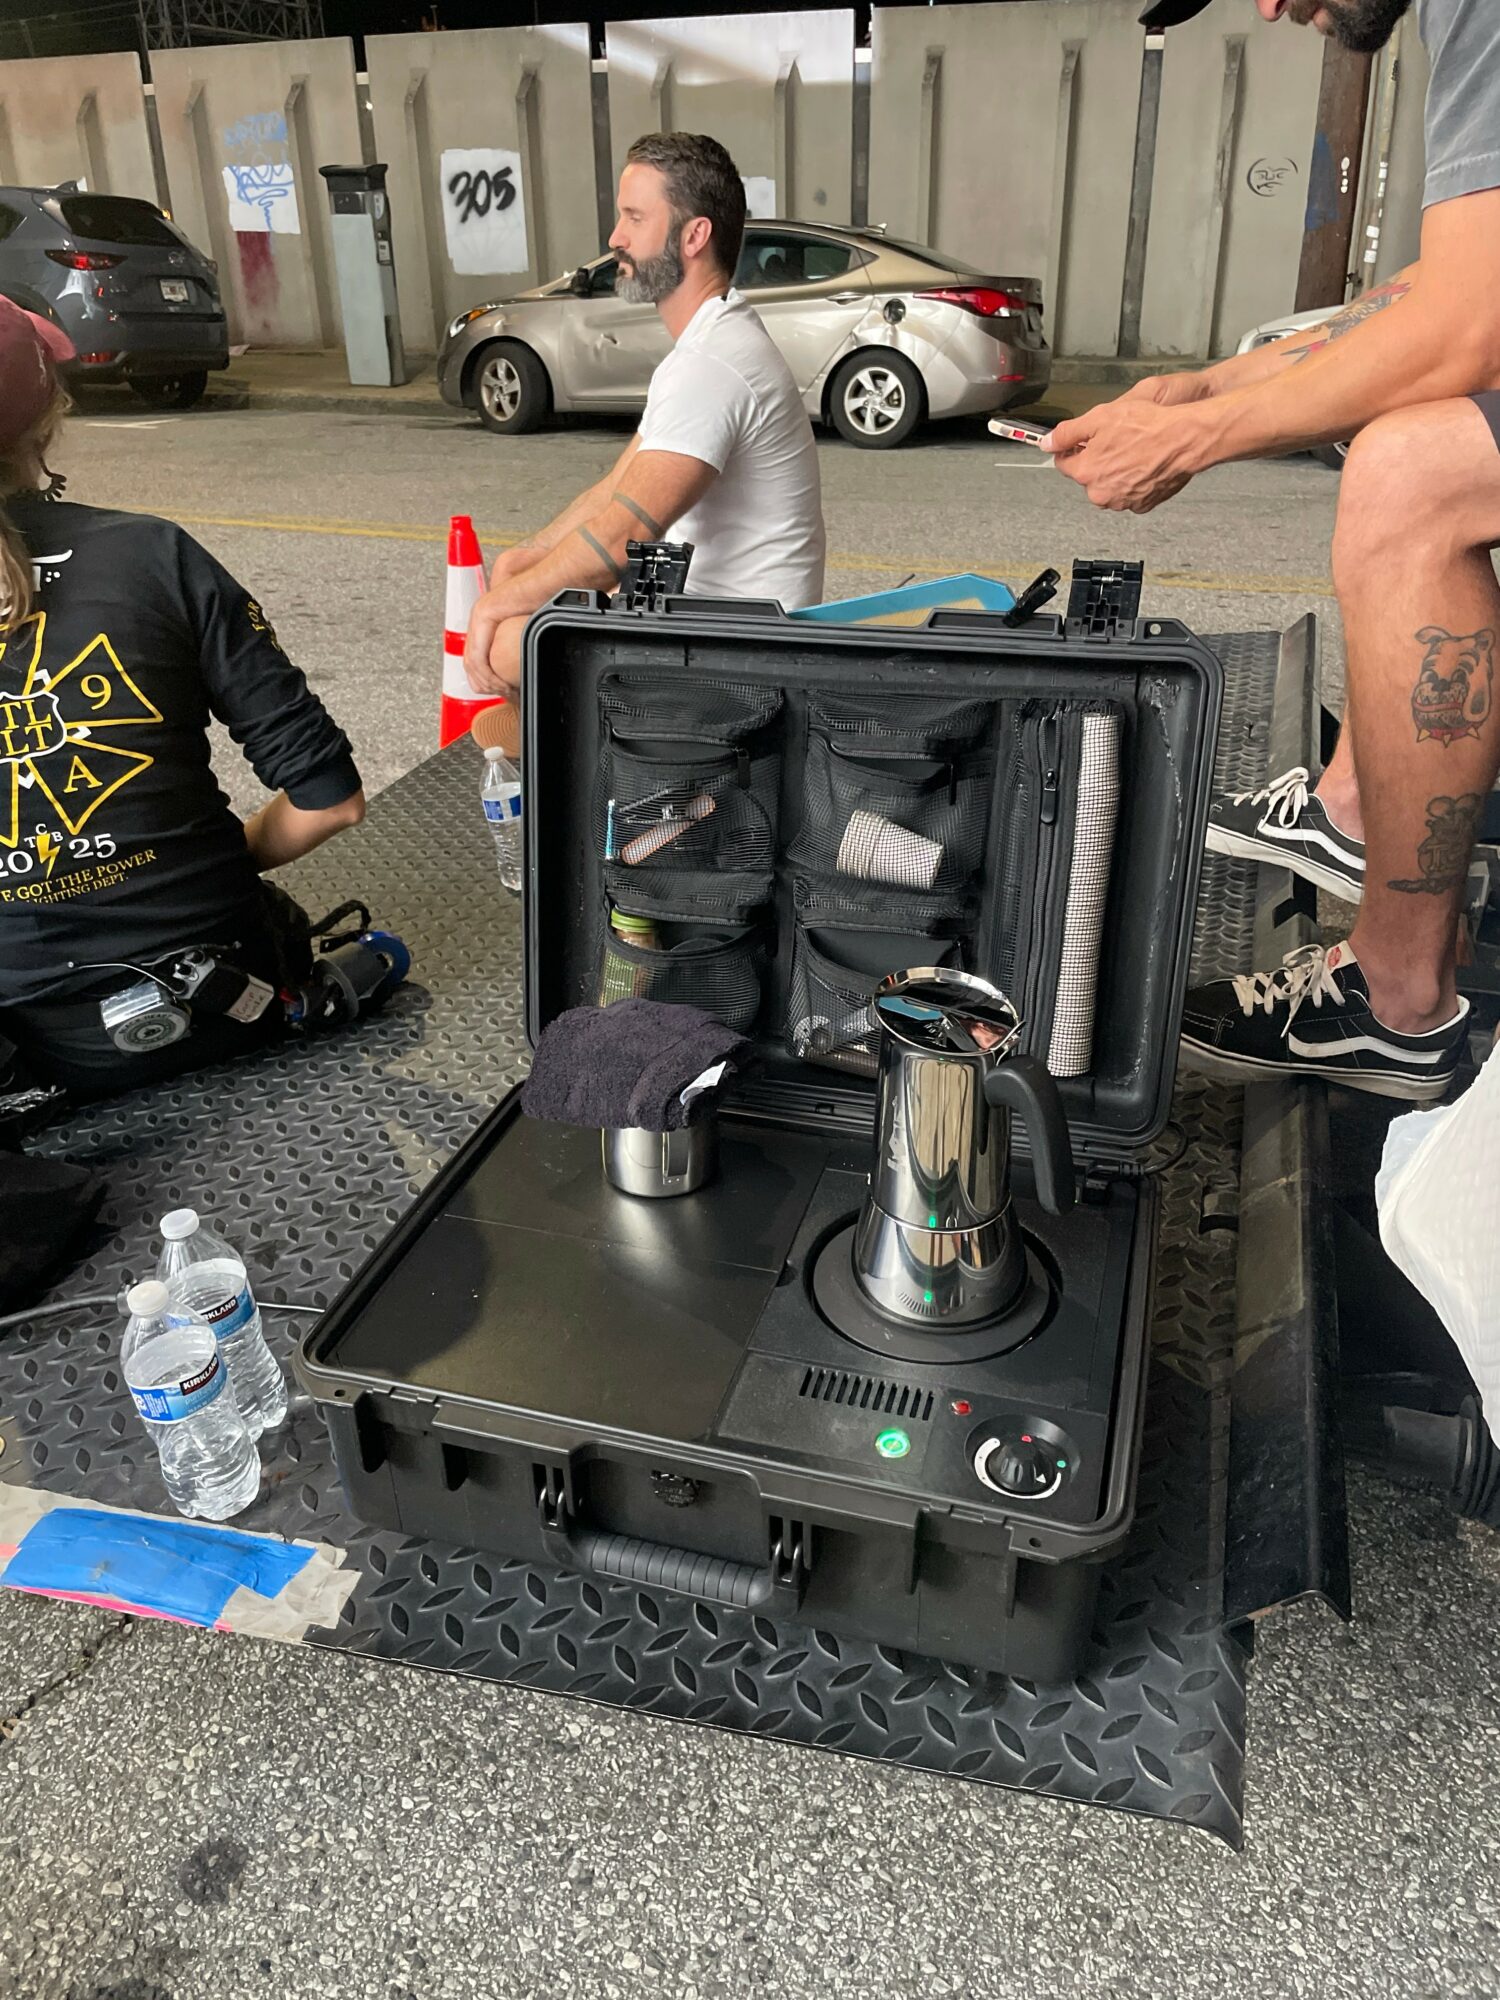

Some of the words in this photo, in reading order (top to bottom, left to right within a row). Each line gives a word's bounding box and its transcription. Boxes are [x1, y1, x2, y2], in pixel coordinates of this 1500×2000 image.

[448, 166, 516, 224] 305
[80, 674, 112, 711] 9
[0, 723, 53, 757] LT
[63, 754, 104, 793] A
[68, 832, 117, 859] 25
[16, 880, 53, 900] GOT
[55, 868, 94, 889] THE
[96, 849, 158, 878] POWER
[26, 885, 91, 904] IGHTING
[203, 1299, 236, 1320] RKLAND
